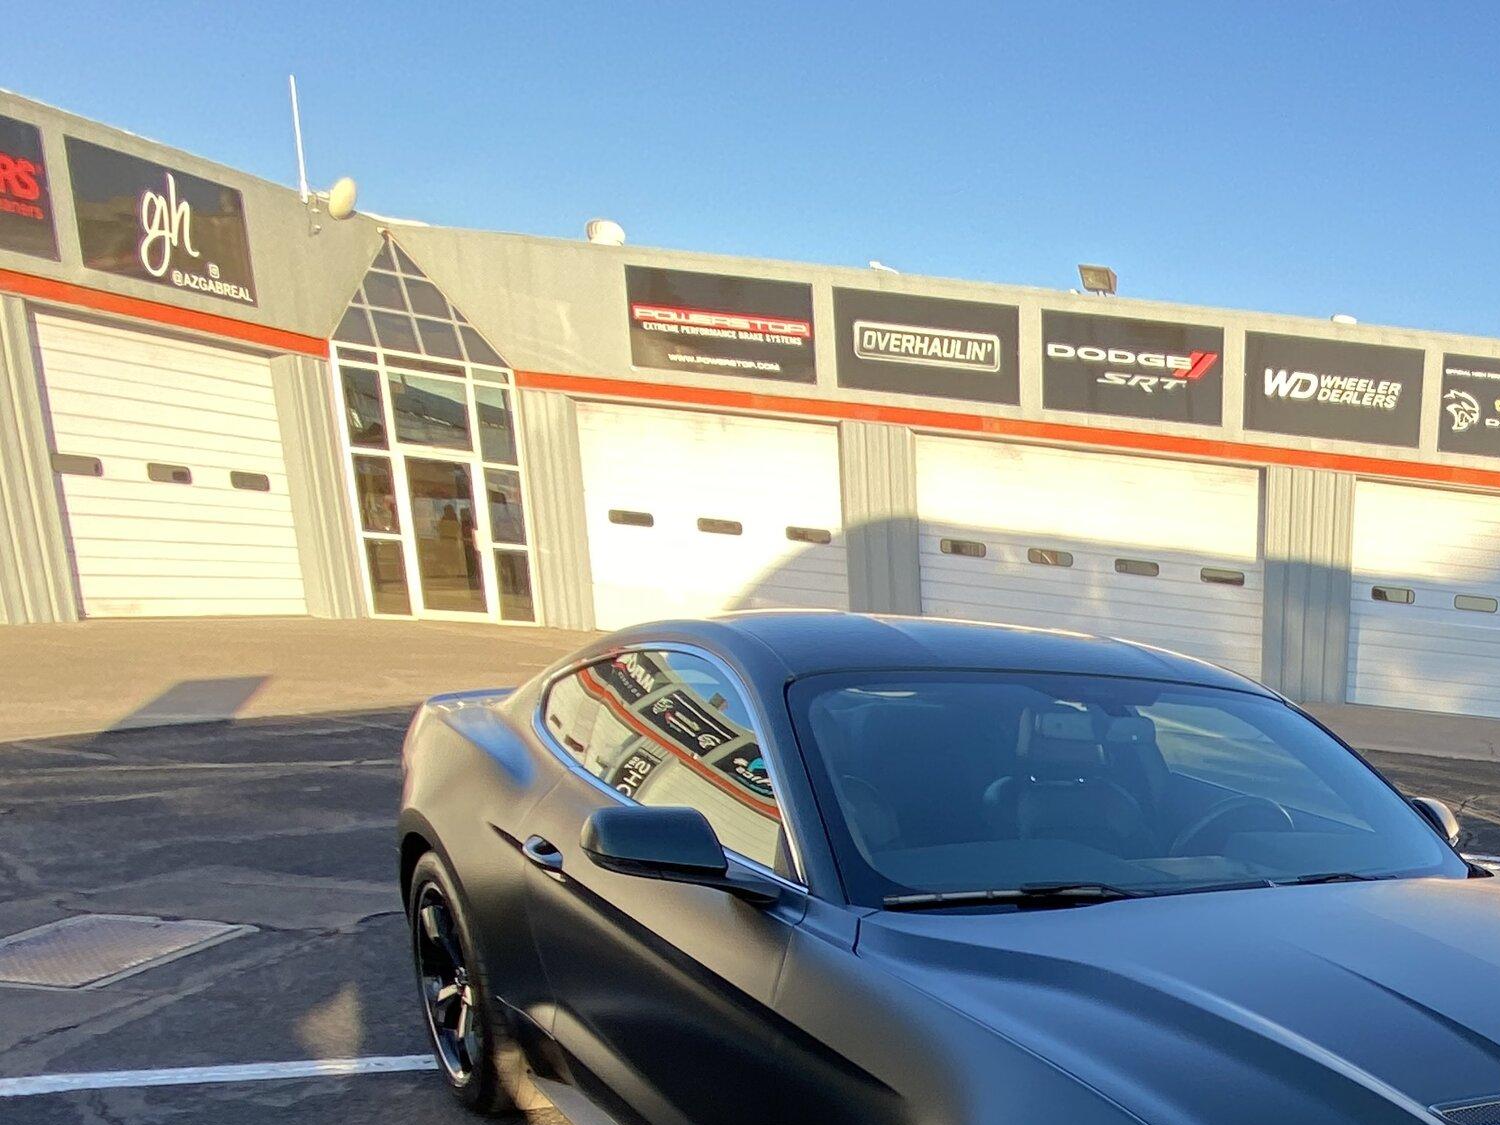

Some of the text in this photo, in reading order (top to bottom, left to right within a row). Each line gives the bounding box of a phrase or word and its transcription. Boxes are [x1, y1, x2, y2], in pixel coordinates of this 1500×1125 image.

[634, 307, 809, 336] POWERSTOP
[681, 325, 737, 340] PERFORMANCE
[739, 331, 763, 342] BRAKE
[766, 334, 802, 346] SYSTEMS
[862, 330, 993, 362] OVERHAULIN'
[1047, 343, 1192, 371] DODGE
[1096, 372, 1187, 394] SRT
[1264, 368, 1318, 400] WD
[1320, 374, 1402, 396] WHEELER
[1317, 388, 1397, 409] DEALERS
